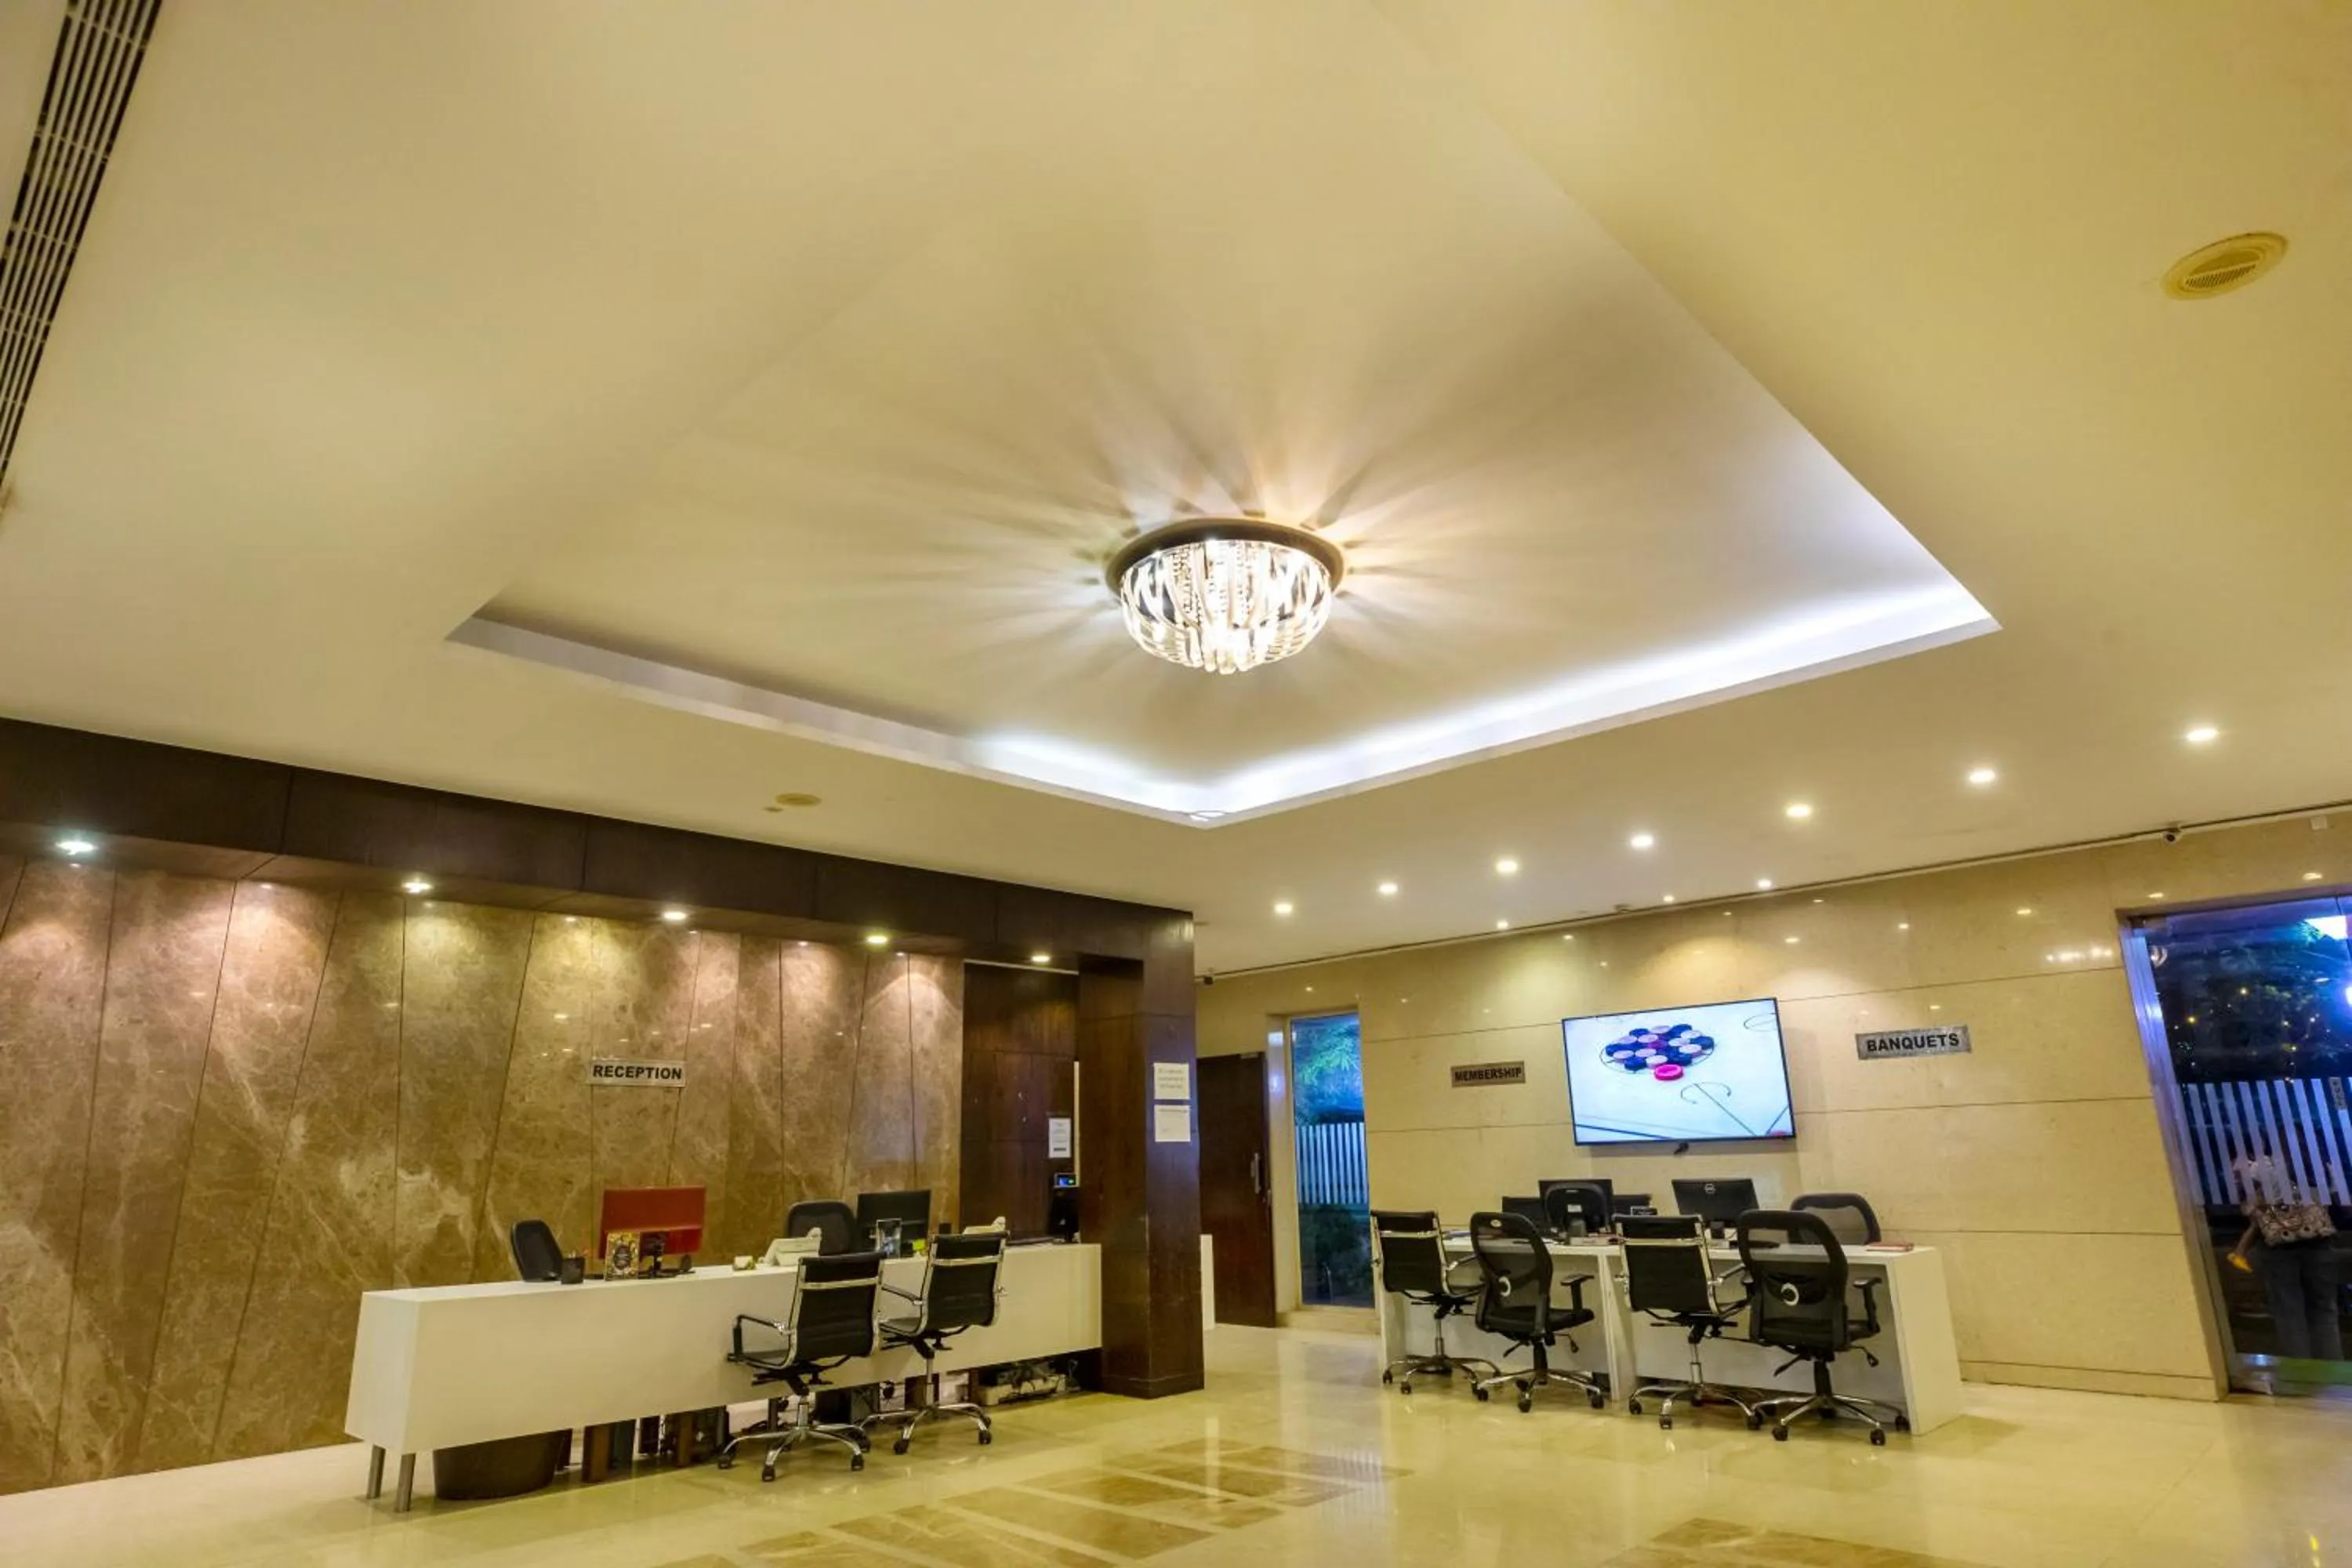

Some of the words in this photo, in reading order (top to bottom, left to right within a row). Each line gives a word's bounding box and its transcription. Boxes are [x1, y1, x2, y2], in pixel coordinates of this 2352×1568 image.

[1867, 1033, 1959, 1051] BANQUETS
[593, 1065, 682, 1080] RECEPTION
[1454, 1067, 1522, 1081] MEMBERSHIP
